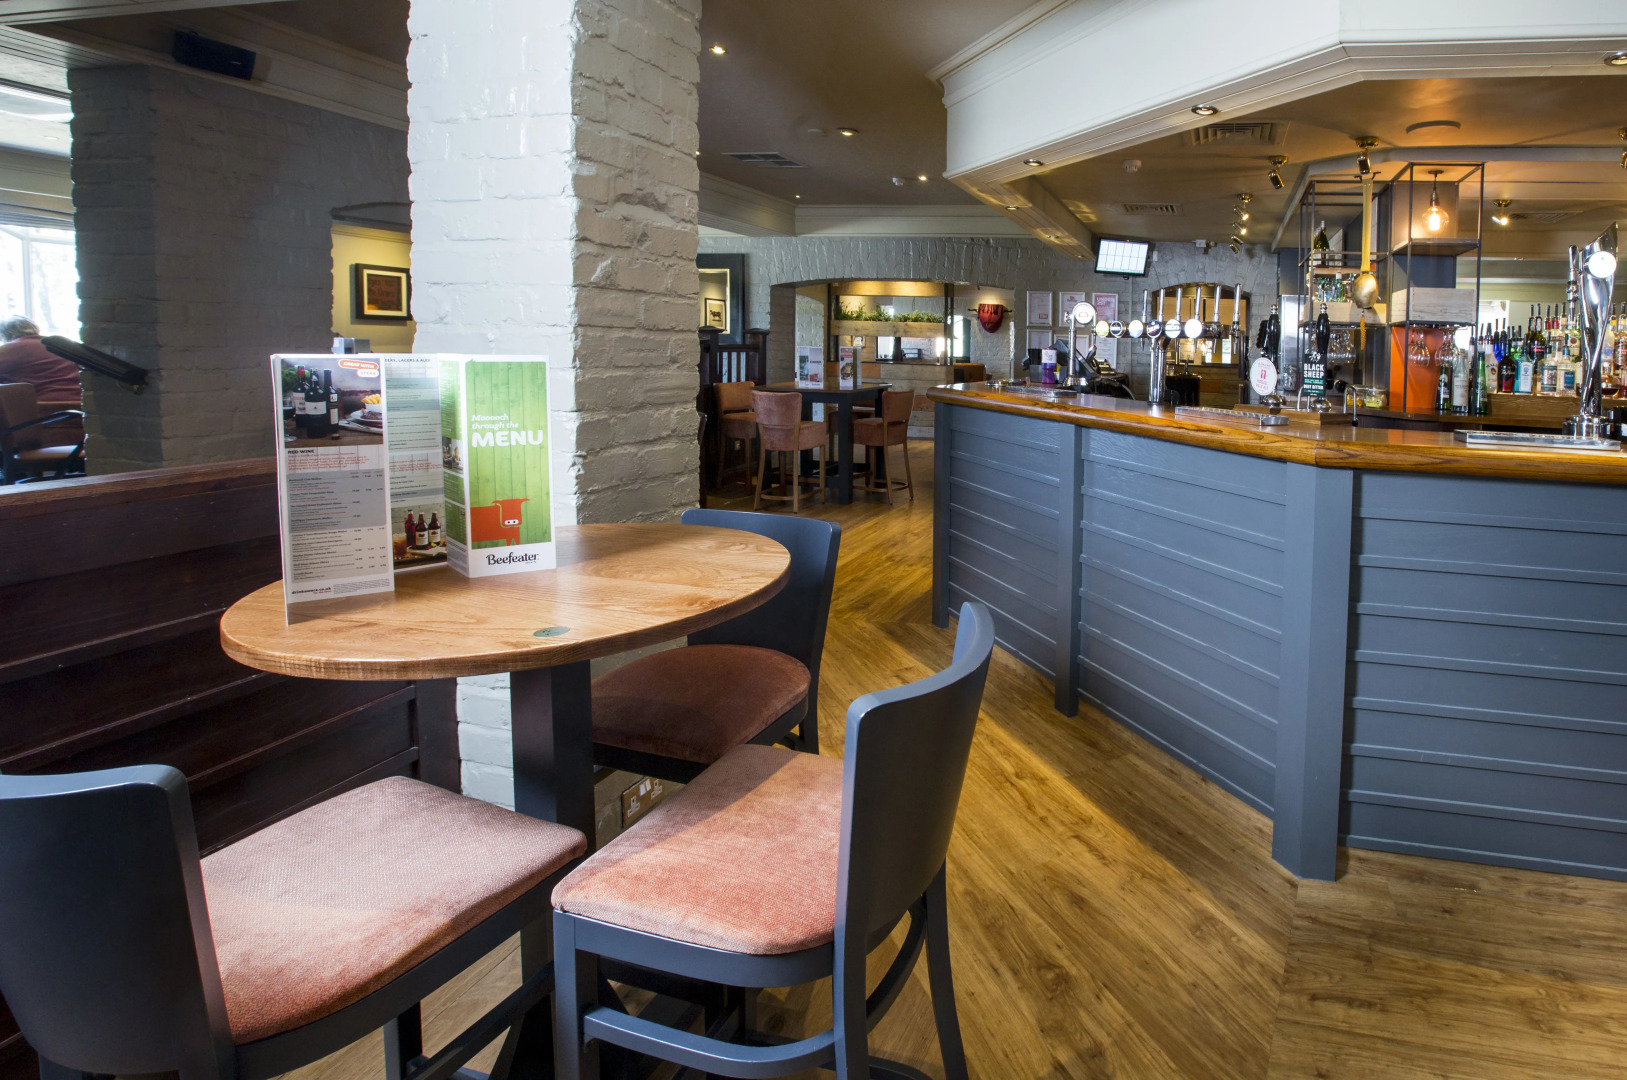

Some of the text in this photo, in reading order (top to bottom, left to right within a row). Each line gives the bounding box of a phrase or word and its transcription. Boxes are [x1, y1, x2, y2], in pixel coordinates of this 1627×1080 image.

[1303, 363, 1325, 371] BLACK
[1303, 370, 1325, 379] SHEEP
[471, 422, 505, 430] through
[471, 429, 544, 448] MENU
[485, 551, 539, 565] Beefeater
